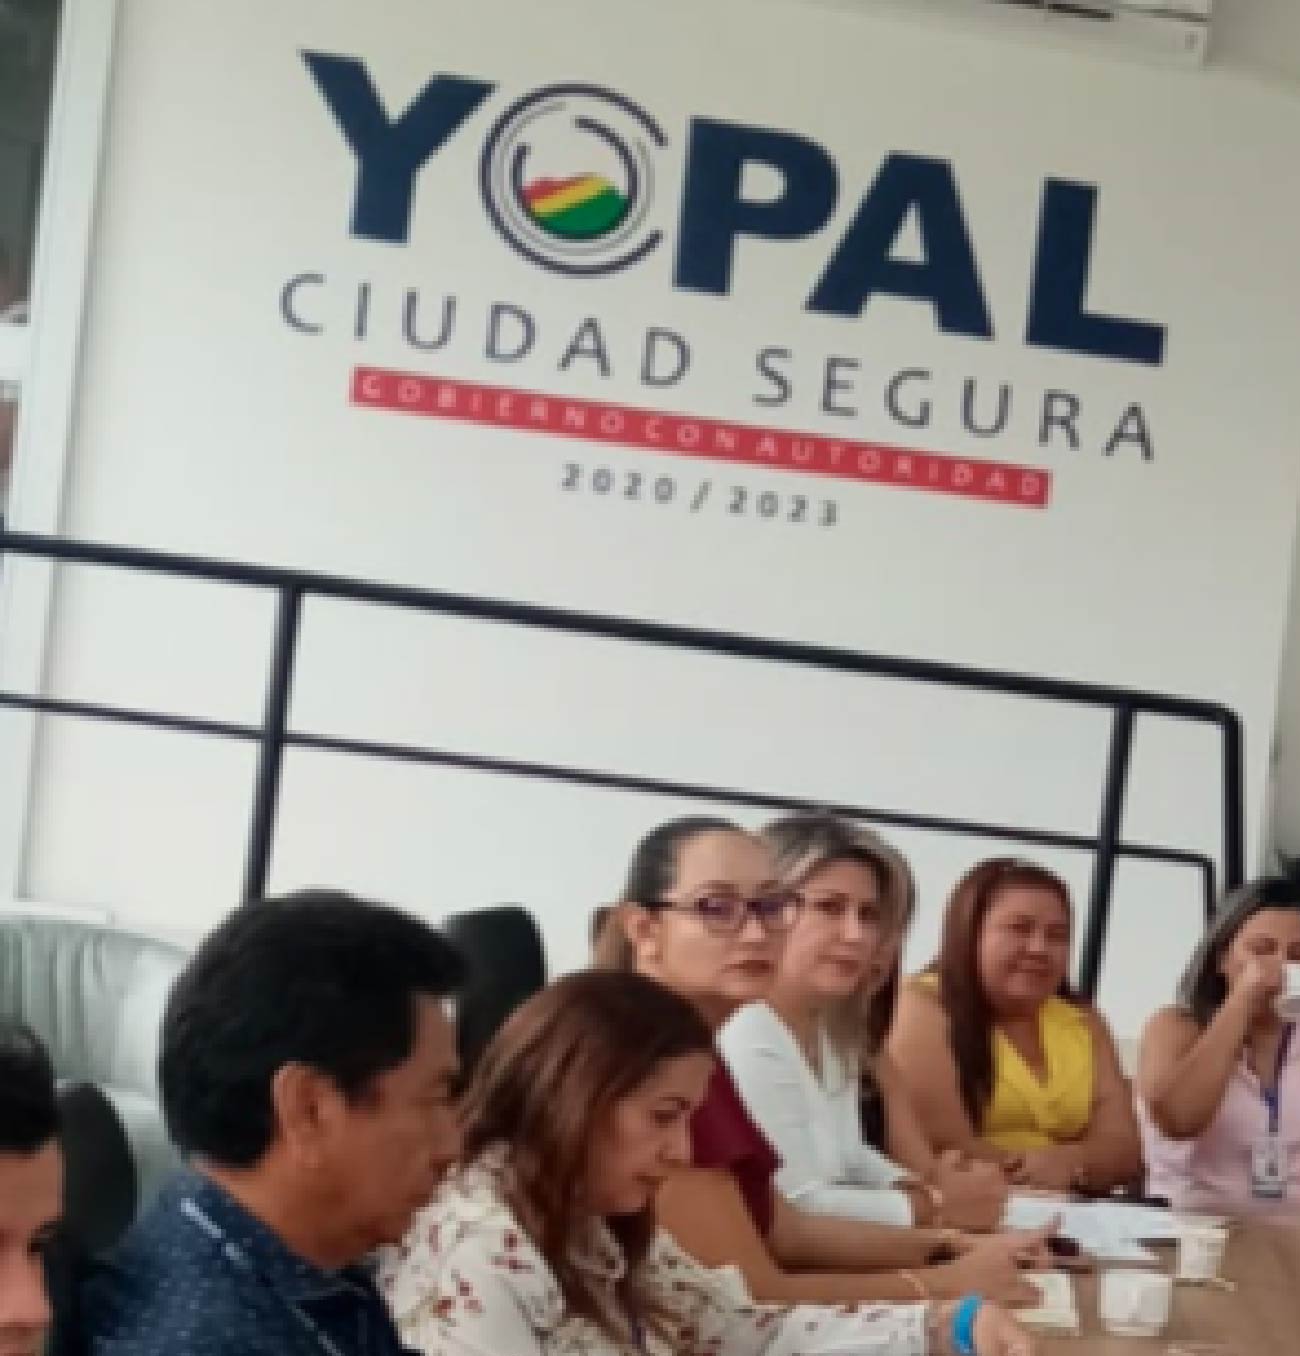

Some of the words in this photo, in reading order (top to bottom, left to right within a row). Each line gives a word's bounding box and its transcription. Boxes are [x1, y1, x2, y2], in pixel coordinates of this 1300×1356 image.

[300, 48, 1169, 367] YOPAL
[279, 272, 692, 388] CIUDAD
[751, 346, 1157, 463] SEGURA
[361, 372, 626, 435] GOBIERNO
[643, 414, 739, 453] CON
[754, 430, 1042, 497] AUTORIDAD
